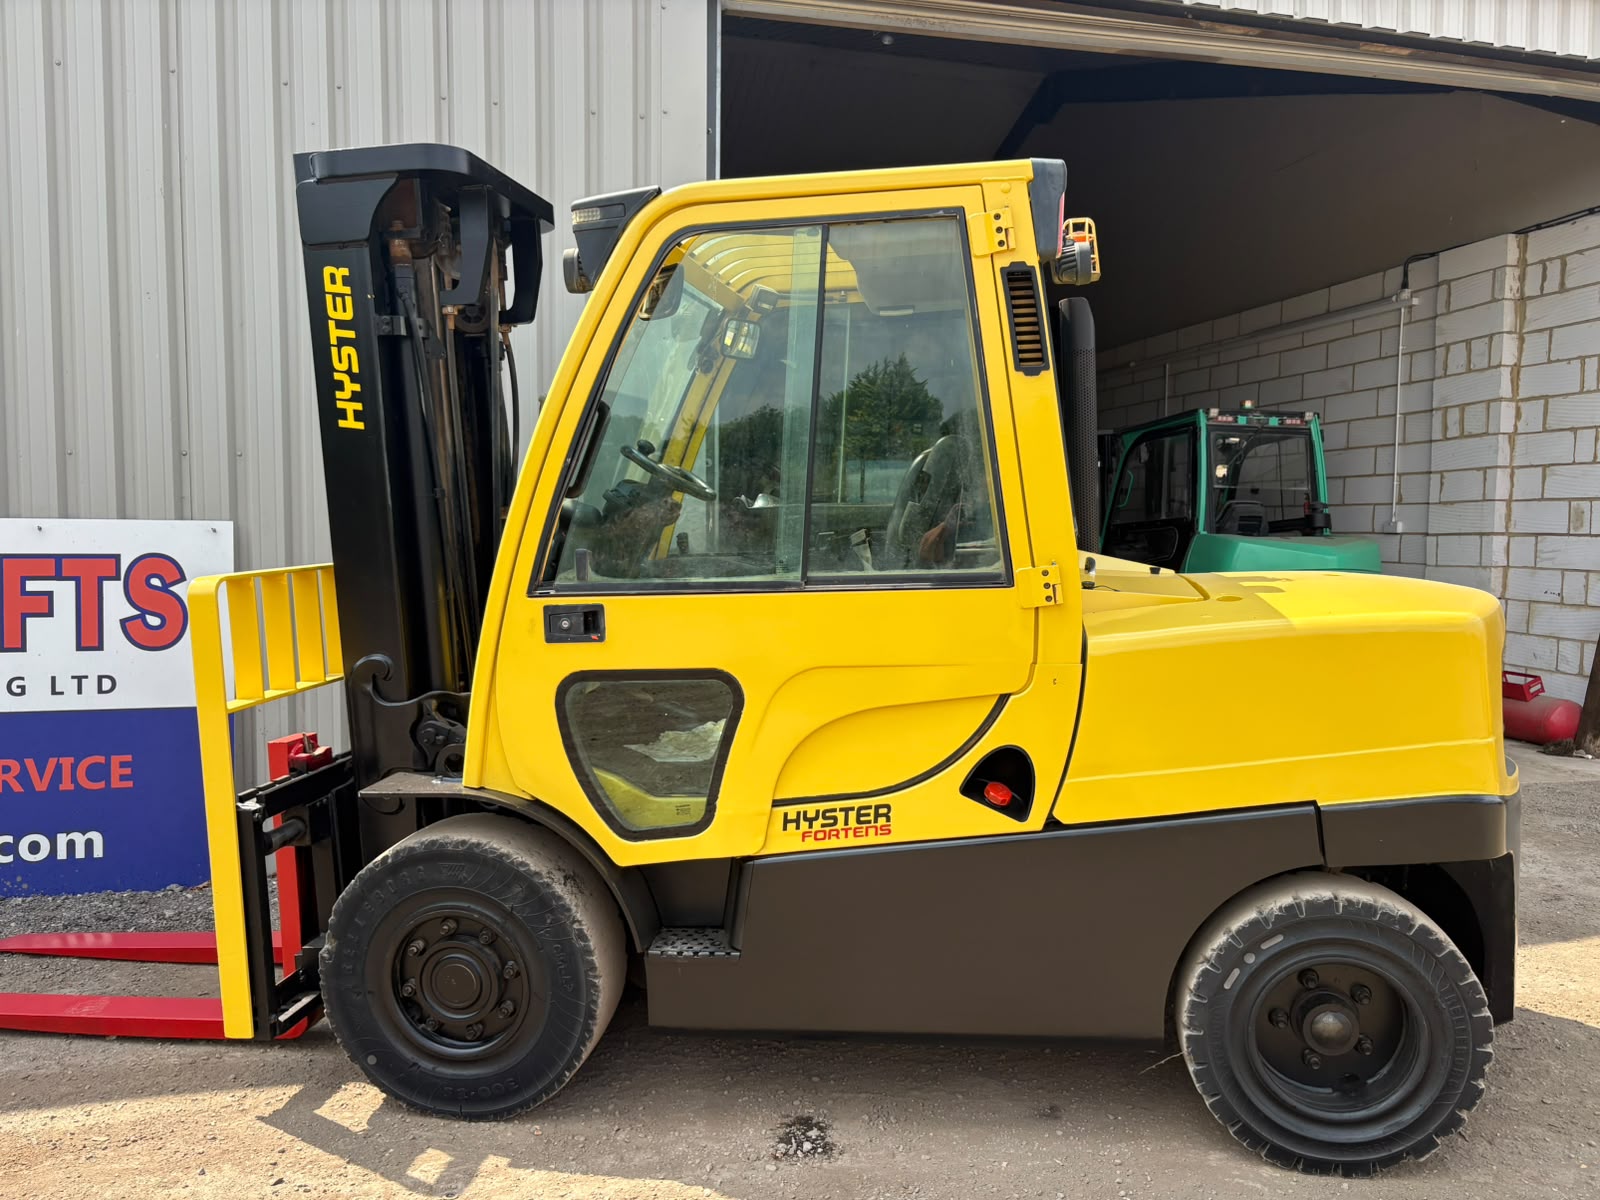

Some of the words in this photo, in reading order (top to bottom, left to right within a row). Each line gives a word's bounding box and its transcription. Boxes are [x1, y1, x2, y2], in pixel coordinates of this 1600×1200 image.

[322, 265, 366, 431] HYSTER
[0, 552, 189, 652] FTS
[6, 676, 27, 697] G
[50, 674, 118, 696] LTD
[782, 803, 892, 831] HYSTER
[801, 824, 892, 842] FORTENS
